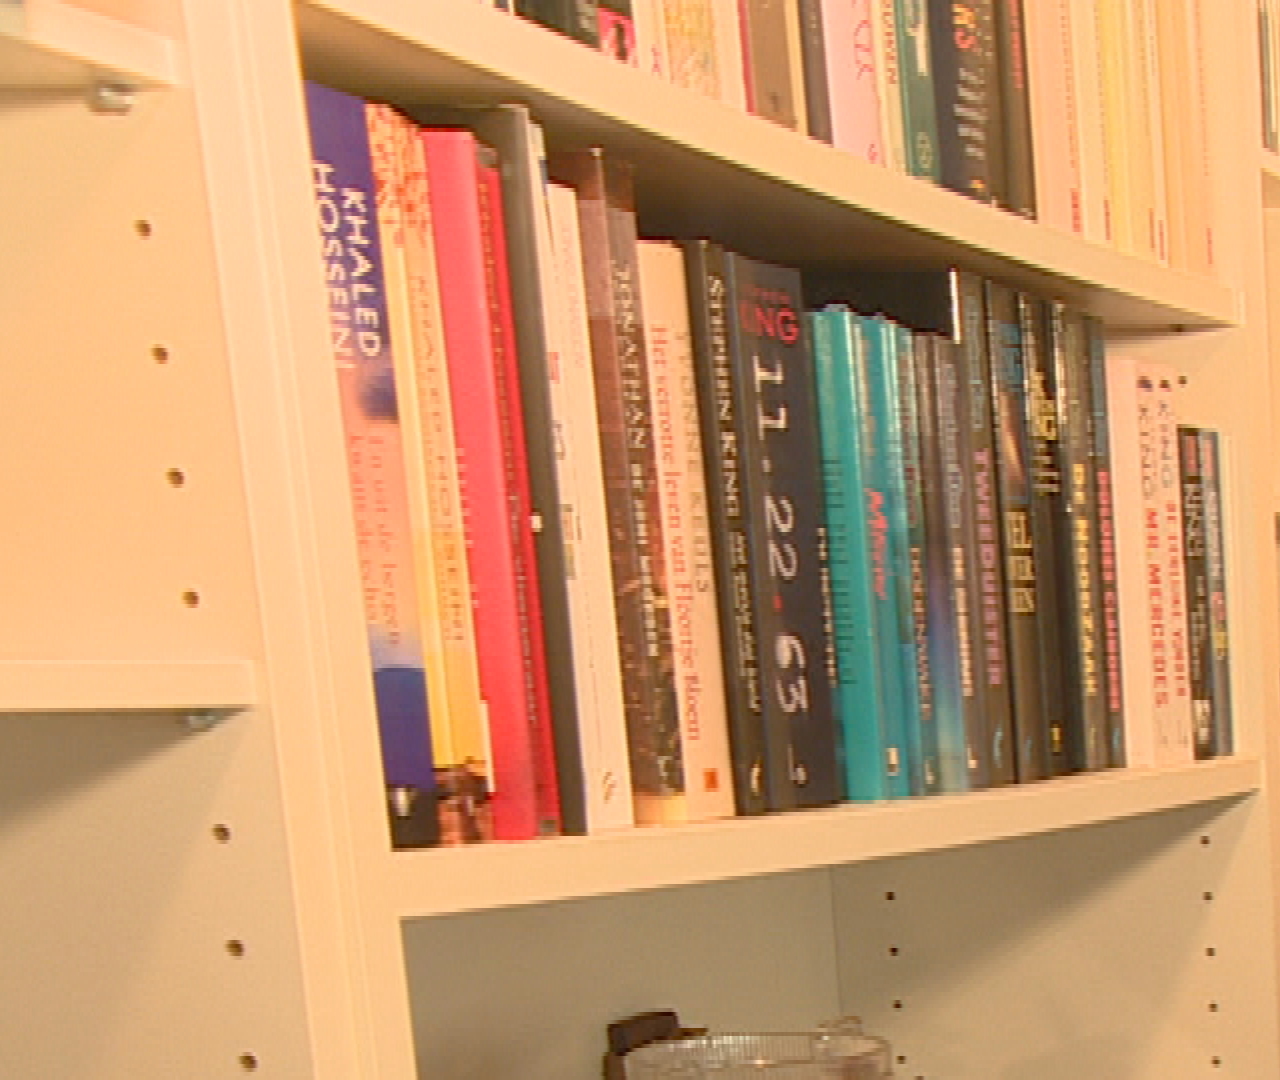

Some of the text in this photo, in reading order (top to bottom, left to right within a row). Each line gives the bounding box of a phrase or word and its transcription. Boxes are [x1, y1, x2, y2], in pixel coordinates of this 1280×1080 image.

[313, 162, 357, 369] HOSSEINI
[341, 187, 382, 357] KHALED
[611, 258, 647, 449] JONATHAN
[652, 326, 669, 366] Het
[708, 274, 739, 517] STEPHEN KING
[1157, 400, 1178, 490] KING
[664, 475, 683, 529] leven
[671, 534, 687, 573] van
[1138, 403, 1158, 501] KING
[1148, 563, 1170, 709] MERCEDES
[675, 583, 696, 668] Floortje
[682, 675, 702, 741] Bloem
